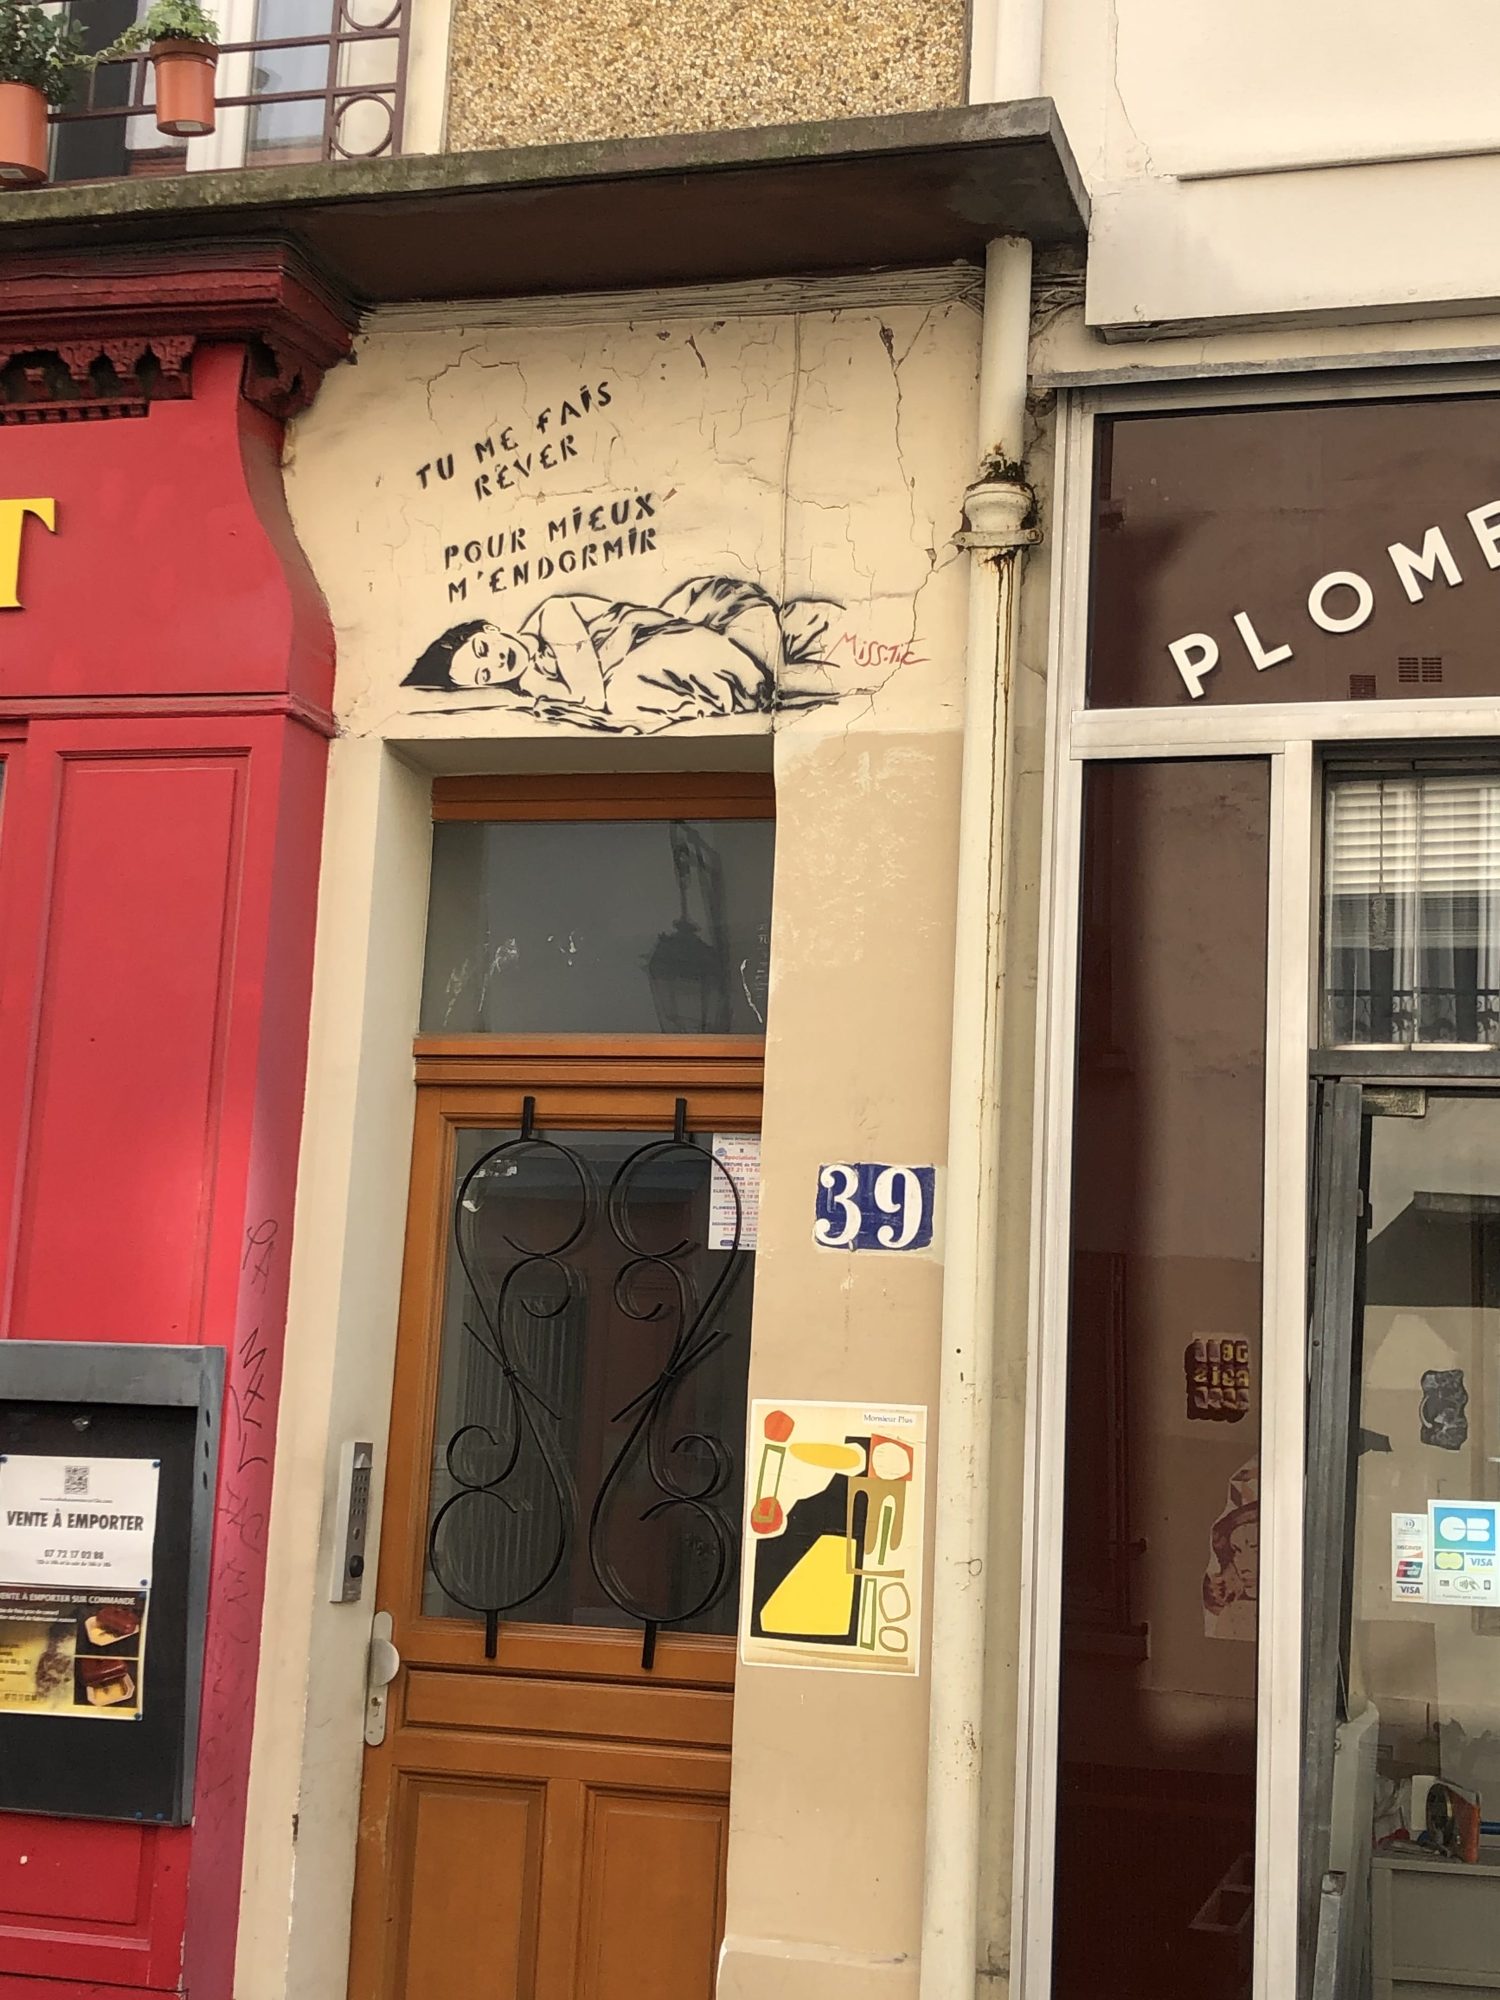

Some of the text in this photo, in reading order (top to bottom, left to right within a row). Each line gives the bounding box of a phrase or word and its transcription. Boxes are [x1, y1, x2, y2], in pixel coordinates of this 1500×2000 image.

[416, 453, 454, 489] TU
[474, 426, 518, 463] ME
[444, 527, 527, 570] POUR
[814, 1165, 923, 1249] 39
[864, 1414, 897, 1422] Monsieur
[7, 1508, 144, 1531] VENTE À EMPORTER
[1470, 1557, 1493, 1567] VISA
[1400, 1586, 1420, 1594] VISA
